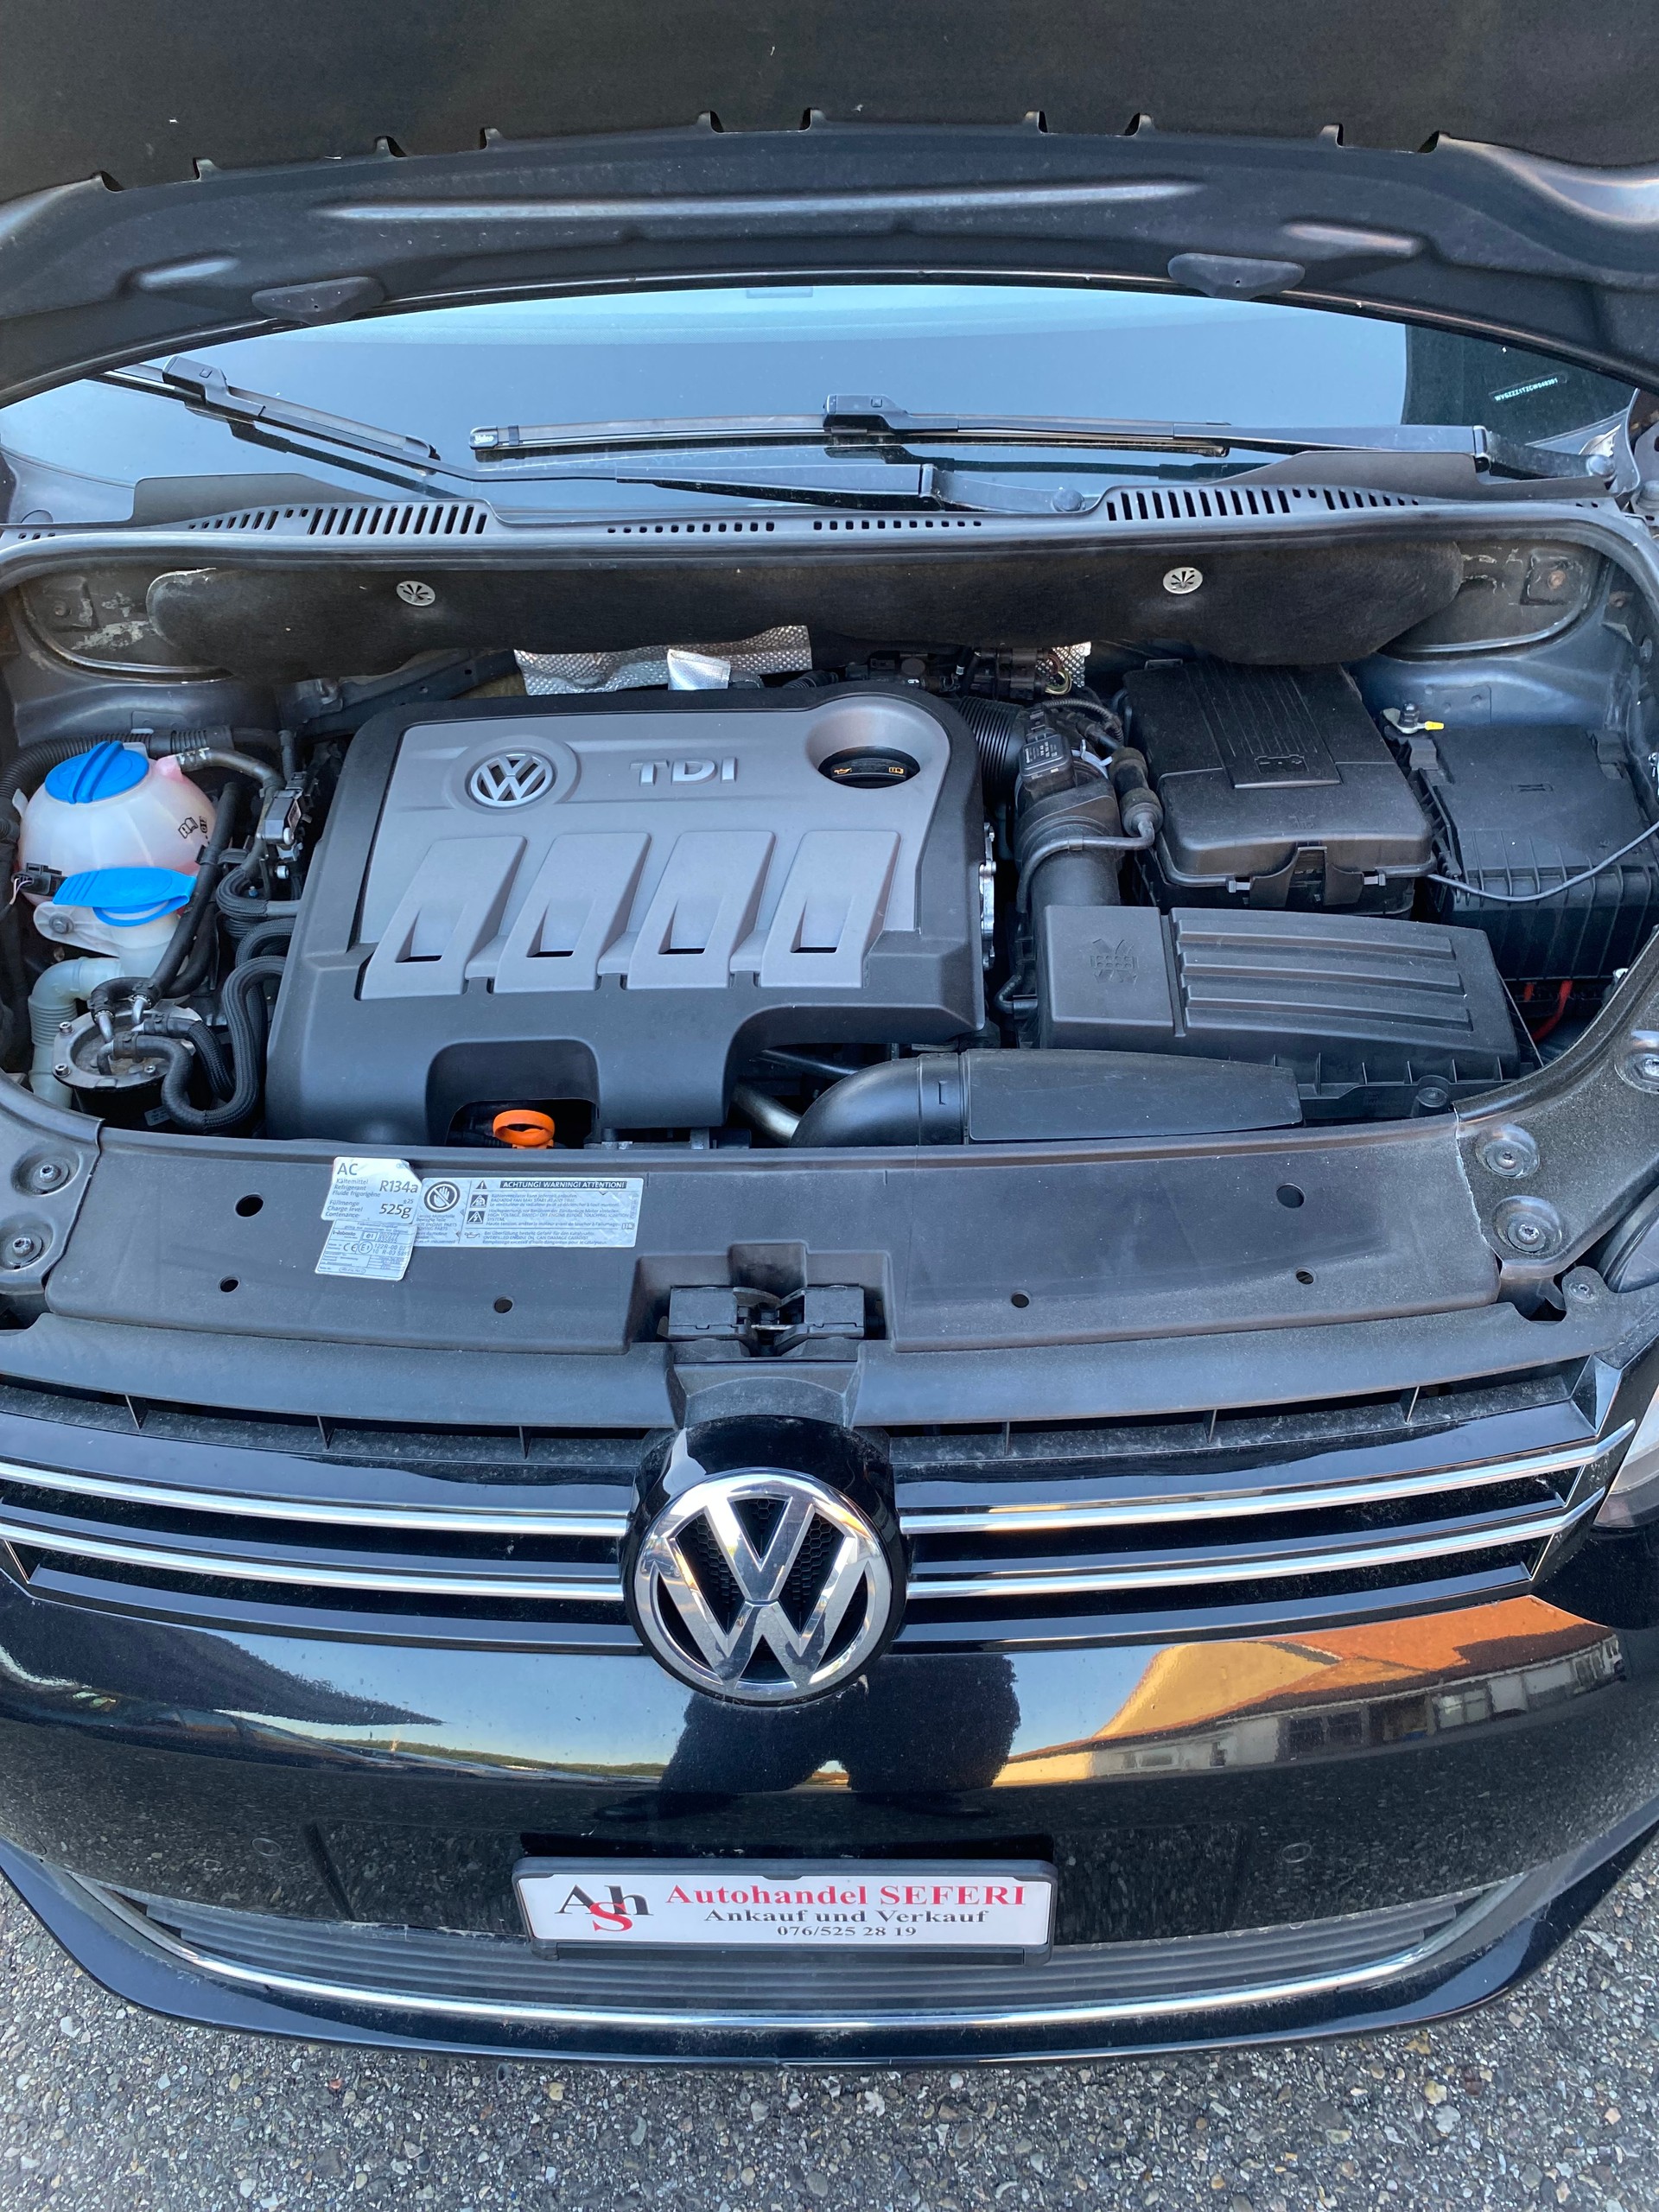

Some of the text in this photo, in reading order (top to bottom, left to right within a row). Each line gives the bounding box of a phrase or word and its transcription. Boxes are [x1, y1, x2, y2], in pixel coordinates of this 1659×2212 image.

[630, 757, 737, 785] TDI
[470, 753, 553, 808] VW
[337, 1163, 358, 1176] AC
[379, 1180, 419, 1193] R134a
[379, 1204, 412, 1219] 525g
[635, 1467, 892, 1697] VW
[665, 1885, 1027, 1906] Autohandel SEFERI
[703, 1909, 989, 1923] Ankauf und Verkauf
[777, 1925, 918, 1937] 076/525 28 19
